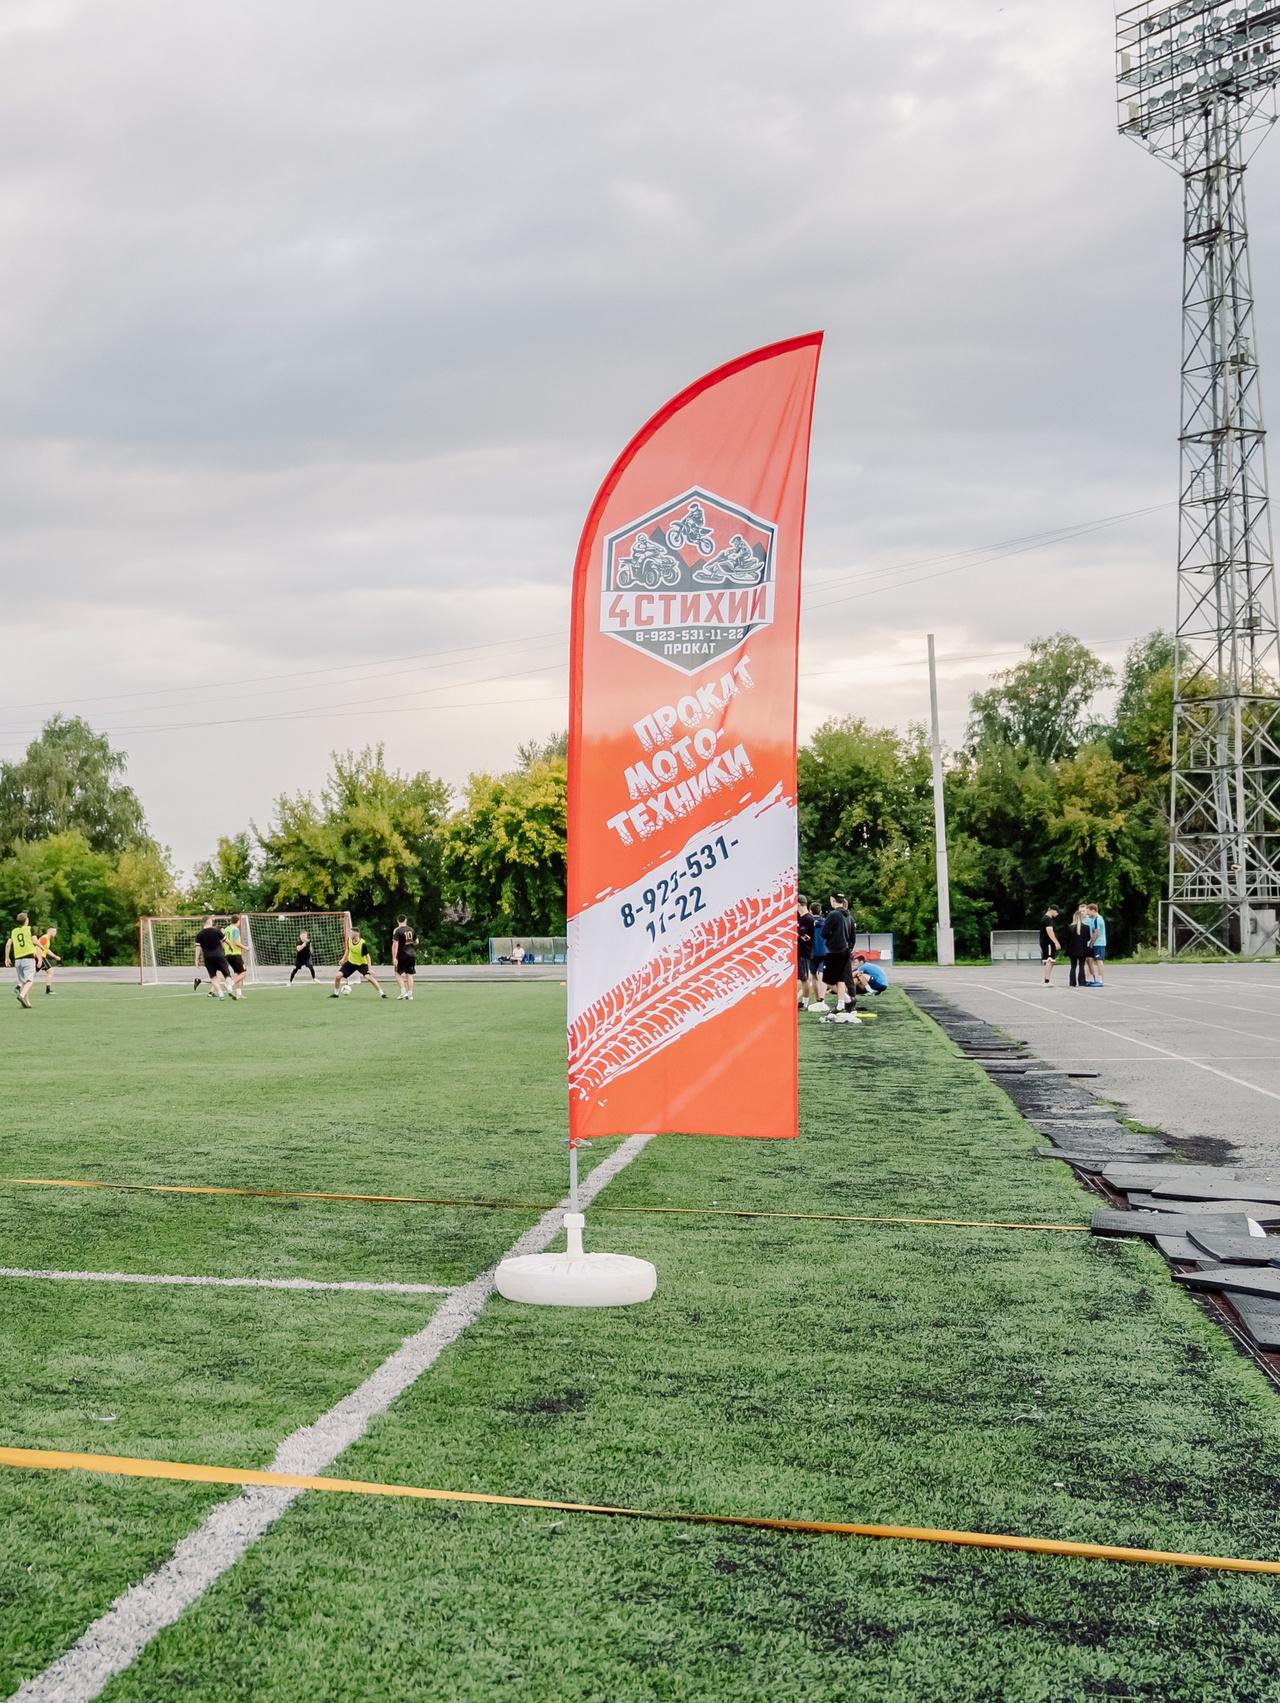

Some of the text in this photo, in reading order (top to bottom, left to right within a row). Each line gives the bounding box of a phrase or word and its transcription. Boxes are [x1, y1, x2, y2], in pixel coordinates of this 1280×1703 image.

[635, 628, 744, 642] 8-923-531-11-22
[663, 642, 716, 655] ПРОКАТ
[633, 654, 755, 751] ПРОКАТ
[623, 727, 724, 800] МОТО-
[606, 743, 754, 848] ТЕХНИКИ
[17, 933, 25, 947] 9
[404, 930, 413, 940] 10
